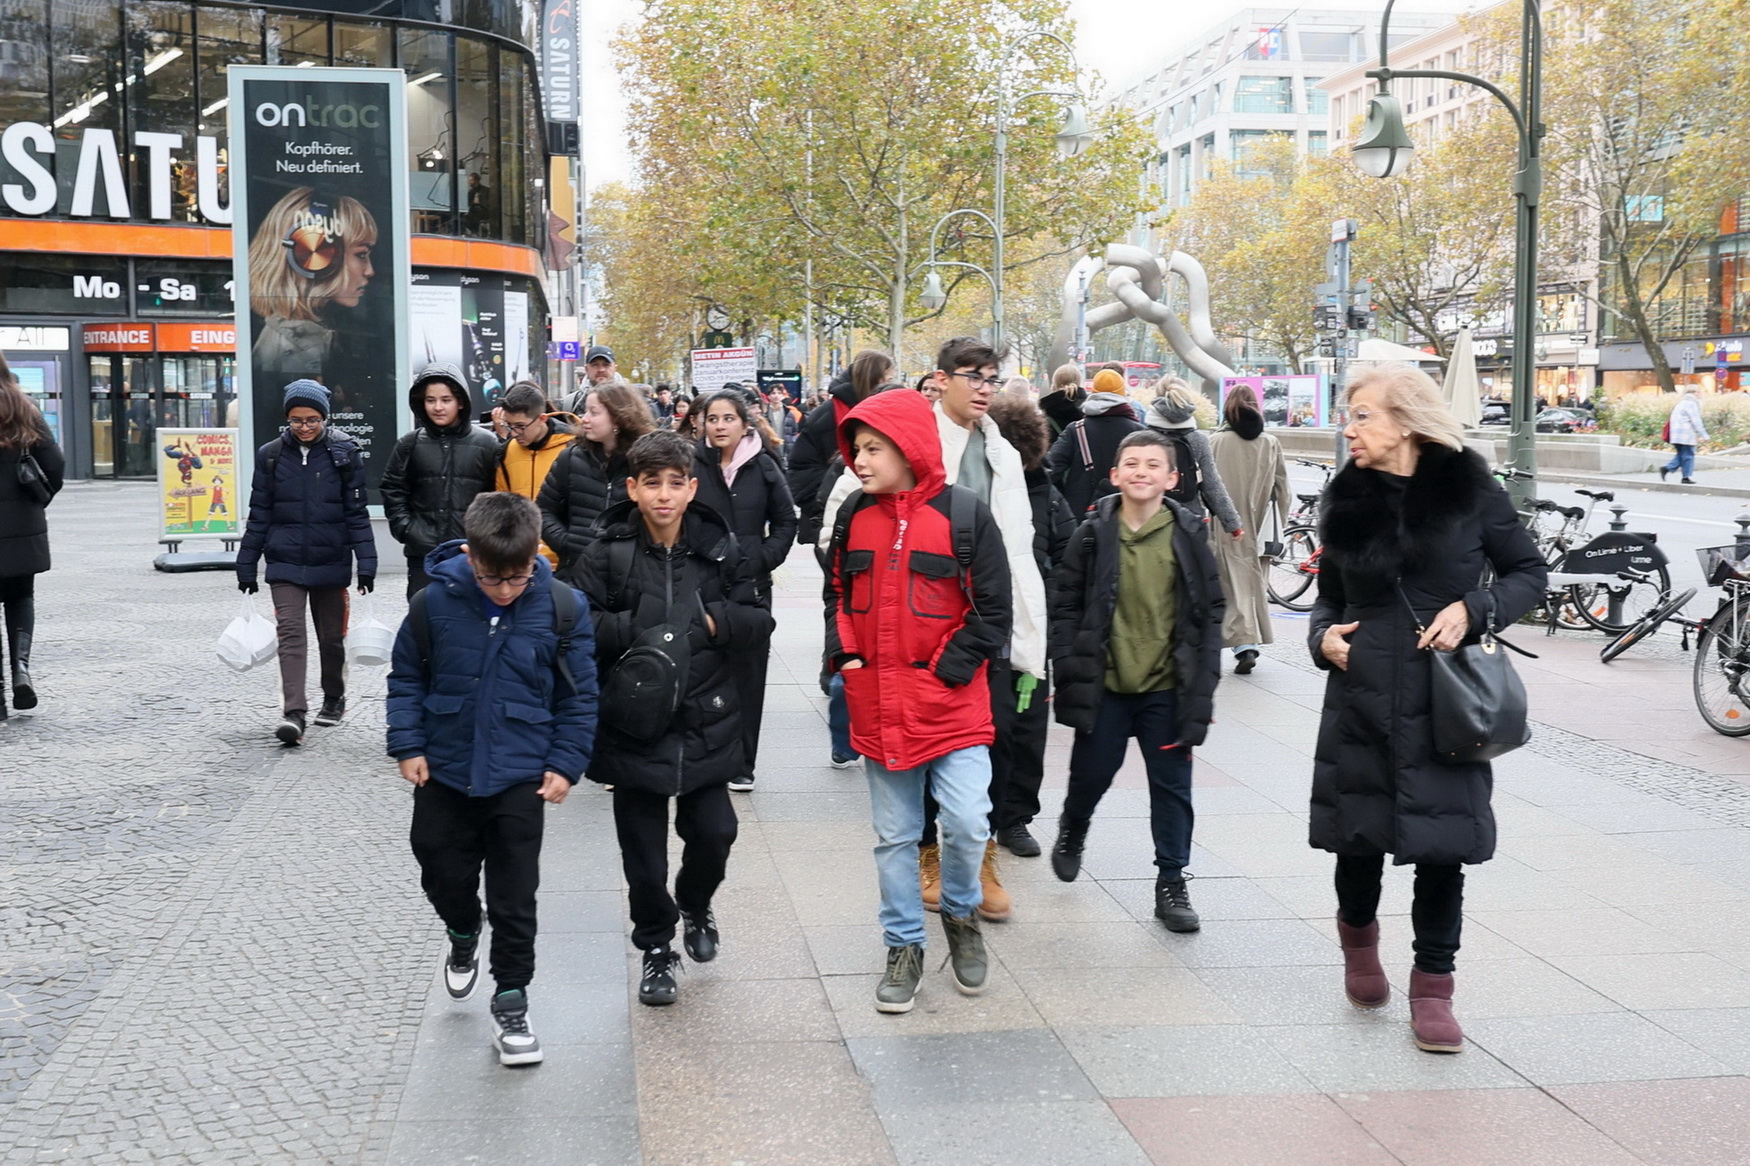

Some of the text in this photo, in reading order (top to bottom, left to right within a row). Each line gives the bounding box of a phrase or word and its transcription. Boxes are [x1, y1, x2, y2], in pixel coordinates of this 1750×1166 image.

[549, 37, 572, 120] SATURN
[285, 141, 354, 157] Kopfhörer.
[275, 159, 364, 174] Neu definiert.
[73, 275, 120, 299] Mo
[160, 278, 197, 301] Sa
[84, 329, 150, 345] ENTRANCE
[190, 330, 235, 344] EING
[331, 412, 364, 420] unsere
[200, 446, 232, 456] MANGA
